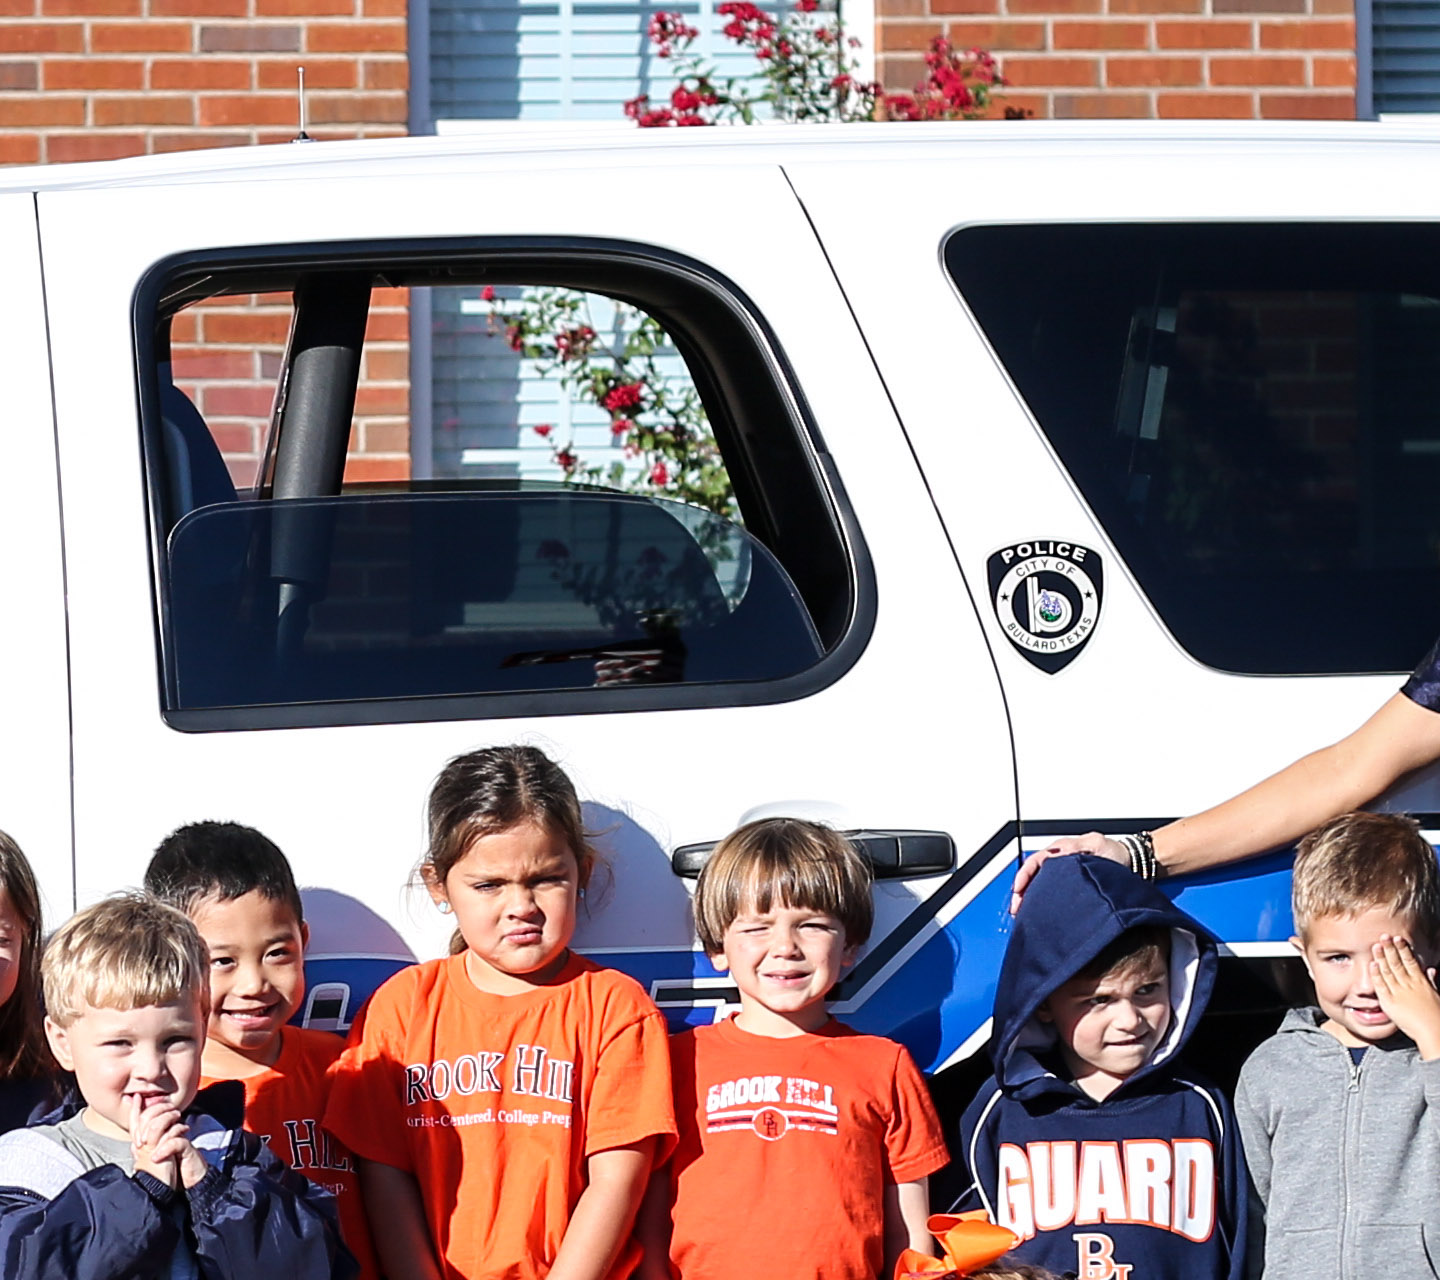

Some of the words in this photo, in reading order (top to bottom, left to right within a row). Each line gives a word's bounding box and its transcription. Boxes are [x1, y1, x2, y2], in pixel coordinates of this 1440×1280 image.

[1001, 541, 1087, 564] POLICE
[1015, 559, 1049, 577] CITY
[1055, 561, 1076, 575] OF
[1007, 622, 1058, 650] BULLARD
[1058, 617, 1092, 648] TEXAS
[405, 1051, 505, 1106] ROOK
[512, 1044, 576, 1105] HIL
[706, 1075, 783, 1113] BROOK
[785, 1076, 839, 1115] HILL
[997, 1138, 1216, 1251] GUARD
